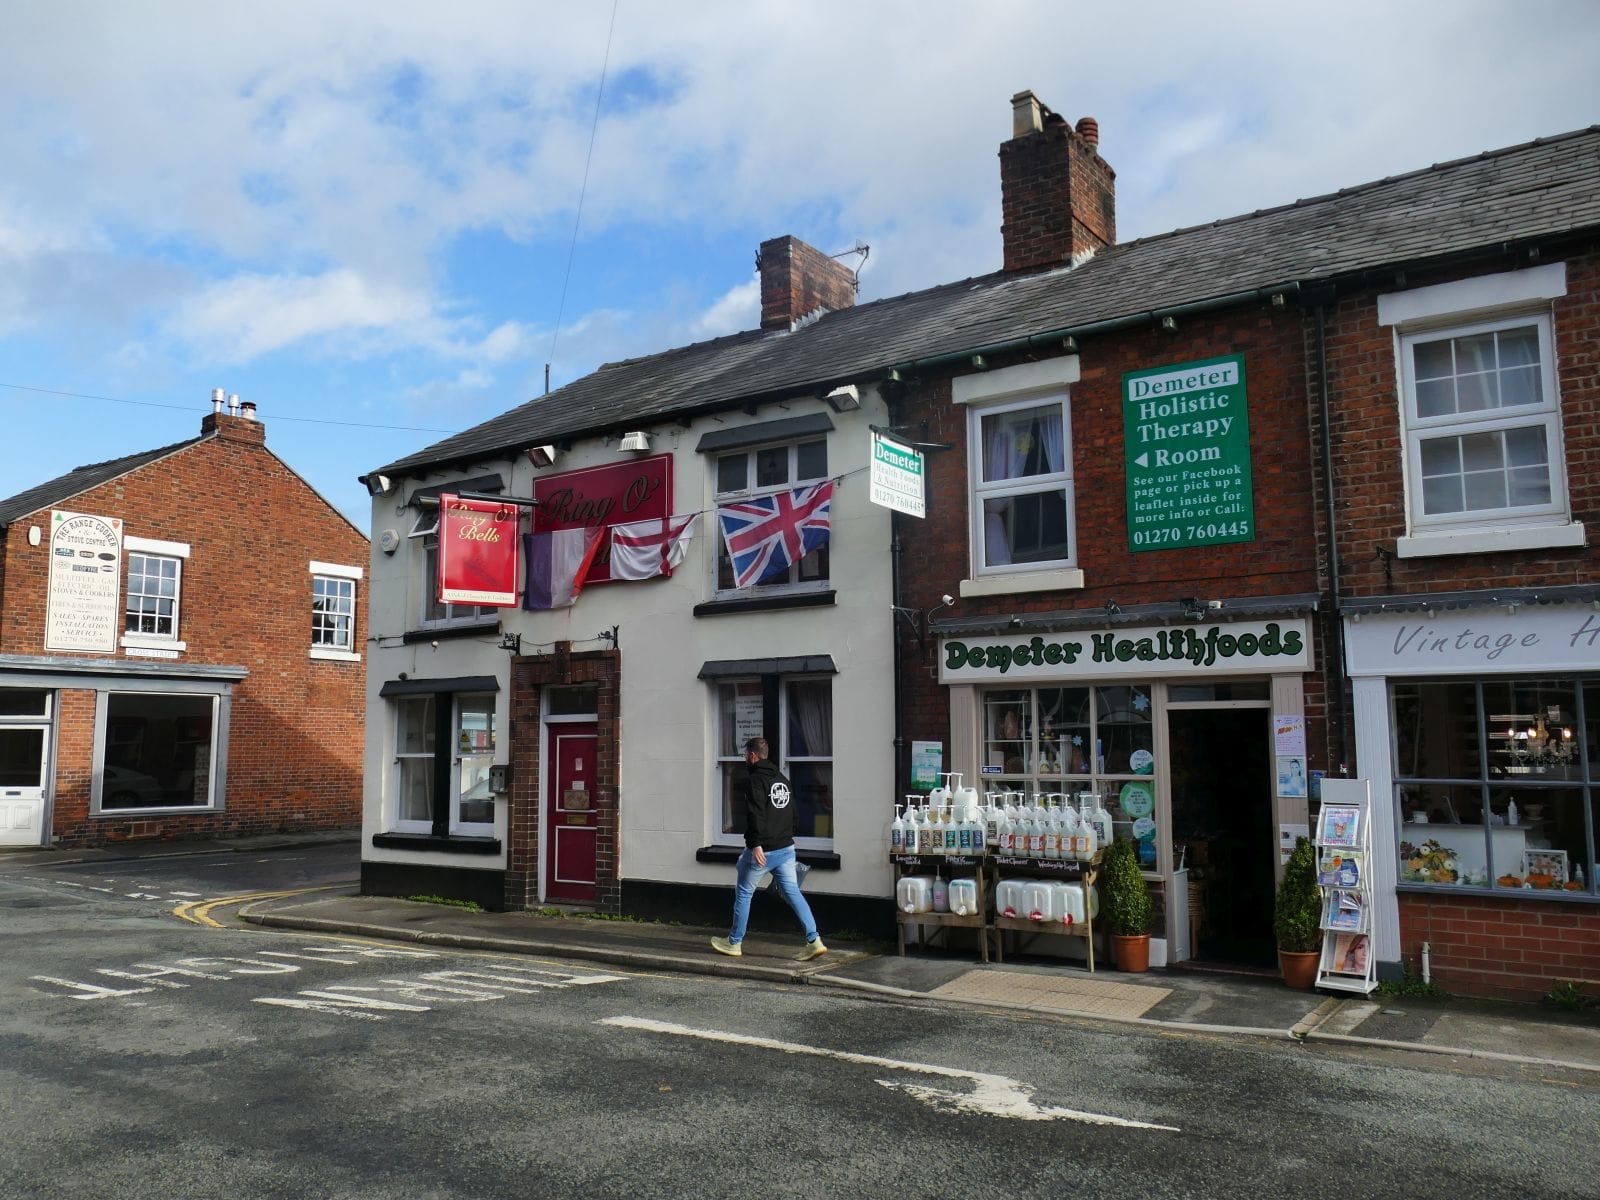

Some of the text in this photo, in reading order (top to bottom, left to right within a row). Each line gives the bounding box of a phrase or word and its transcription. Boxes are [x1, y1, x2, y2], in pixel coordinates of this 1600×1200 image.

[1134, 369, 1232, 397] Demeter
[1139, 392, 1229, 421] Holistic
[1137, 416, 1234, 443] Therapy
[876, 441, 920, 472] Demeter
[1155, 446, 1221, 467] Room
[1133, 465, 1242, 486] See our Facebook
[1134, 487, 1161, 499] page
[1166, 485, 1178, 493] or
[1183, 480, 1210, 493] pick
[1215, 480, 1230, 489] up
[539, 488, 614, 526] Ring
[1135, 491, 1241, 511] leaflet inside for
[1135, 503, 1245, 523] more info or Call:
[56, 519, 117, 547] THE RANGE COOKER
[67, 535, 106, 547] STOVE CENTRE
[458, 524, 500, 542] Bells
[1133, 520, 1248, 544] 01270 760445
[52, 586, 77, 595] STOVES
[85, 590, 115, 598] COOKERS
[53, 612, 77, 620] SALES
[55, 620, 109, 630] INSTALLATION
[66, 629, 97, 637] SERVICE
[1393, 625, 1541, 660] Vintage
[127, 648, 177, 658] CROSS STREET
[944, 623, 1303, 673] Demeter Healthfoods
[27, 945, 440, 1000] RIGHT
[251, 964, 631, 1020] TURN
